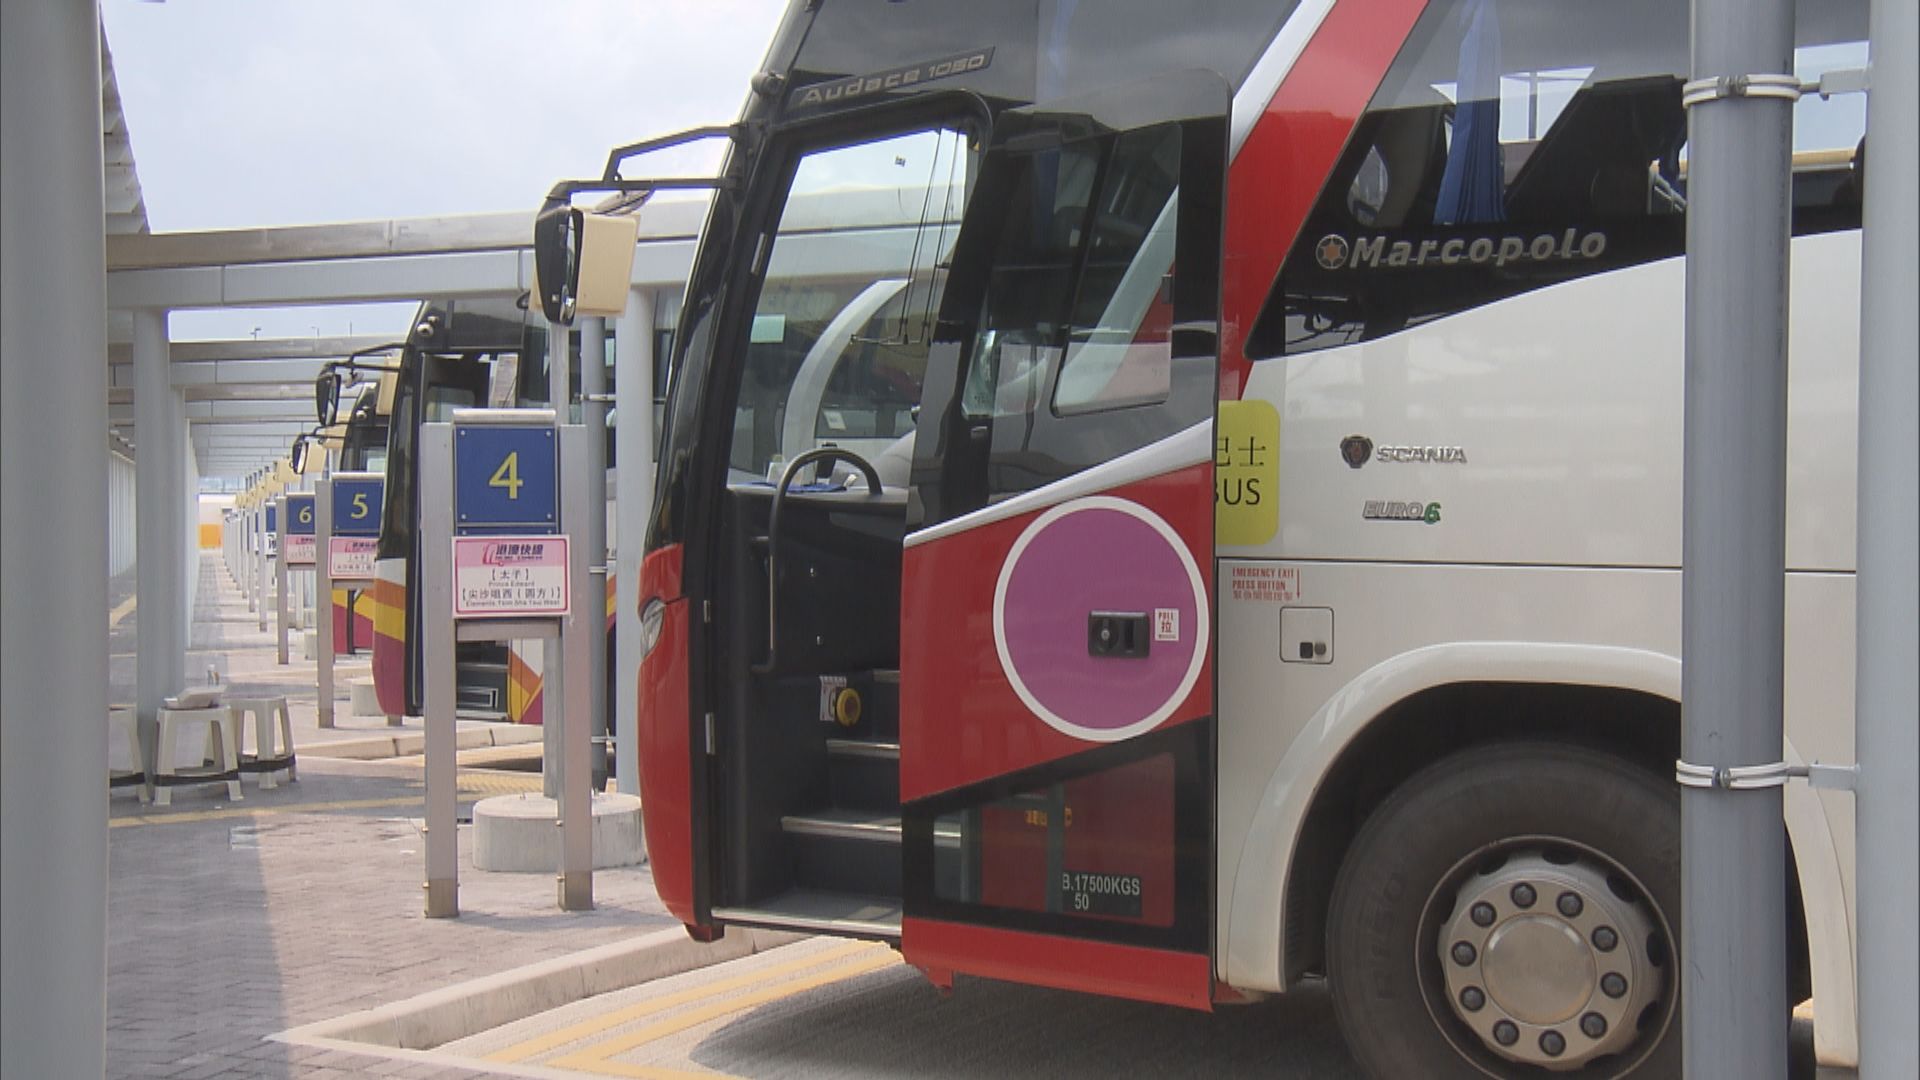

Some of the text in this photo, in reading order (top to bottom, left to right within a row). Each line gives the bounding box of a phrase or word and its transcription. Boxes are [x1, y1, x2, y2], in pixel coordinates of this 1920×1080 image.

[802, 69, 920, 103] Audace
[1350, 228, 1606, 268] Marcopolo
[1376, 446, 1467, 464] SCANIA
[489, 451, 524, 499] 4
[299, 506, 312, 524] 6
[351, 493, 368, 519] 5
[1232, 567, 1294, 579] EMERGENCY EXIT
[1232, 580, 1286, 592] PRESS BUTTON
[1074, 893, 1089, 911] 50
